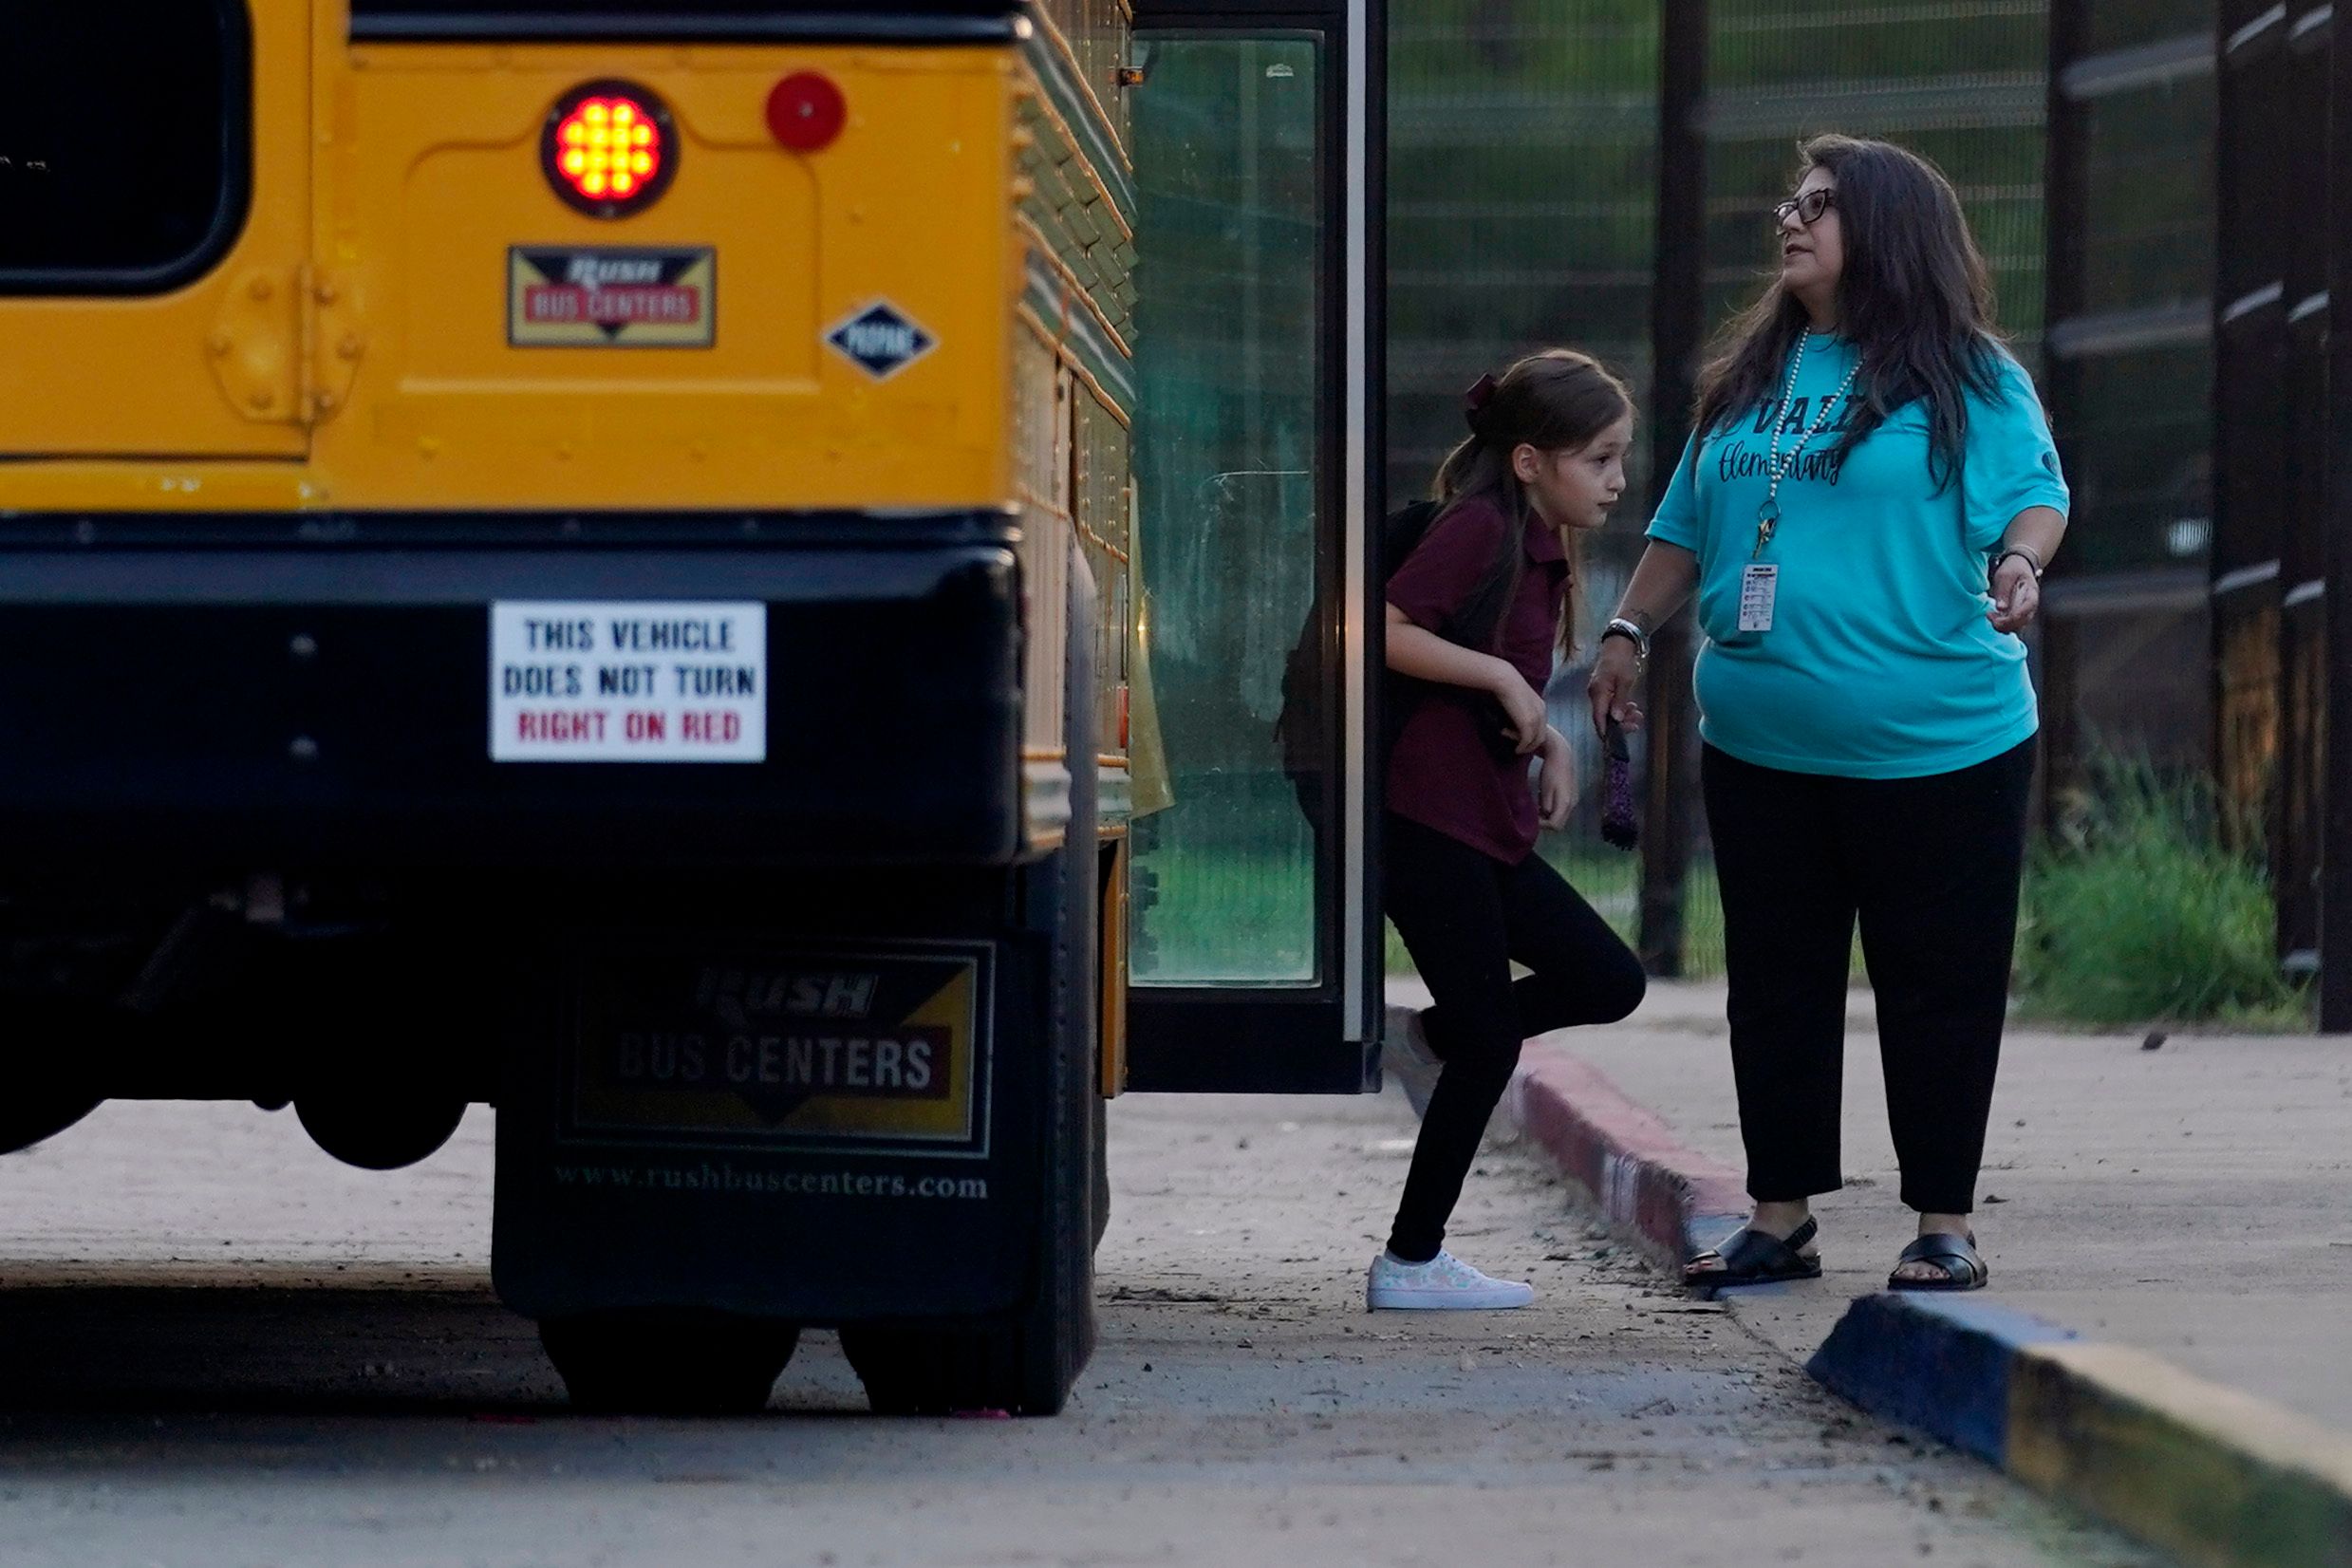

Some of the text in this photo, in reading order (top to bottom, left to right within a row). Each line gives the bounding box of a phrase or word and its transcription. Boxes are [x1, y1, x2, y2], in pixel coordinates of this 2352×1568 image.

[533, 292, 692, 320] BUS CENTERS
[526, 619, 735, 651] THIS VEHICLE
[503, 665, 756, 697] DOES NOT TURN
[518, 712, 740, 742] RIGHT ON RED
[619, 1032, 934, 1090] BUS CENTERS
[553, 1161, 989, 1200] www.rushbuscenters.com
